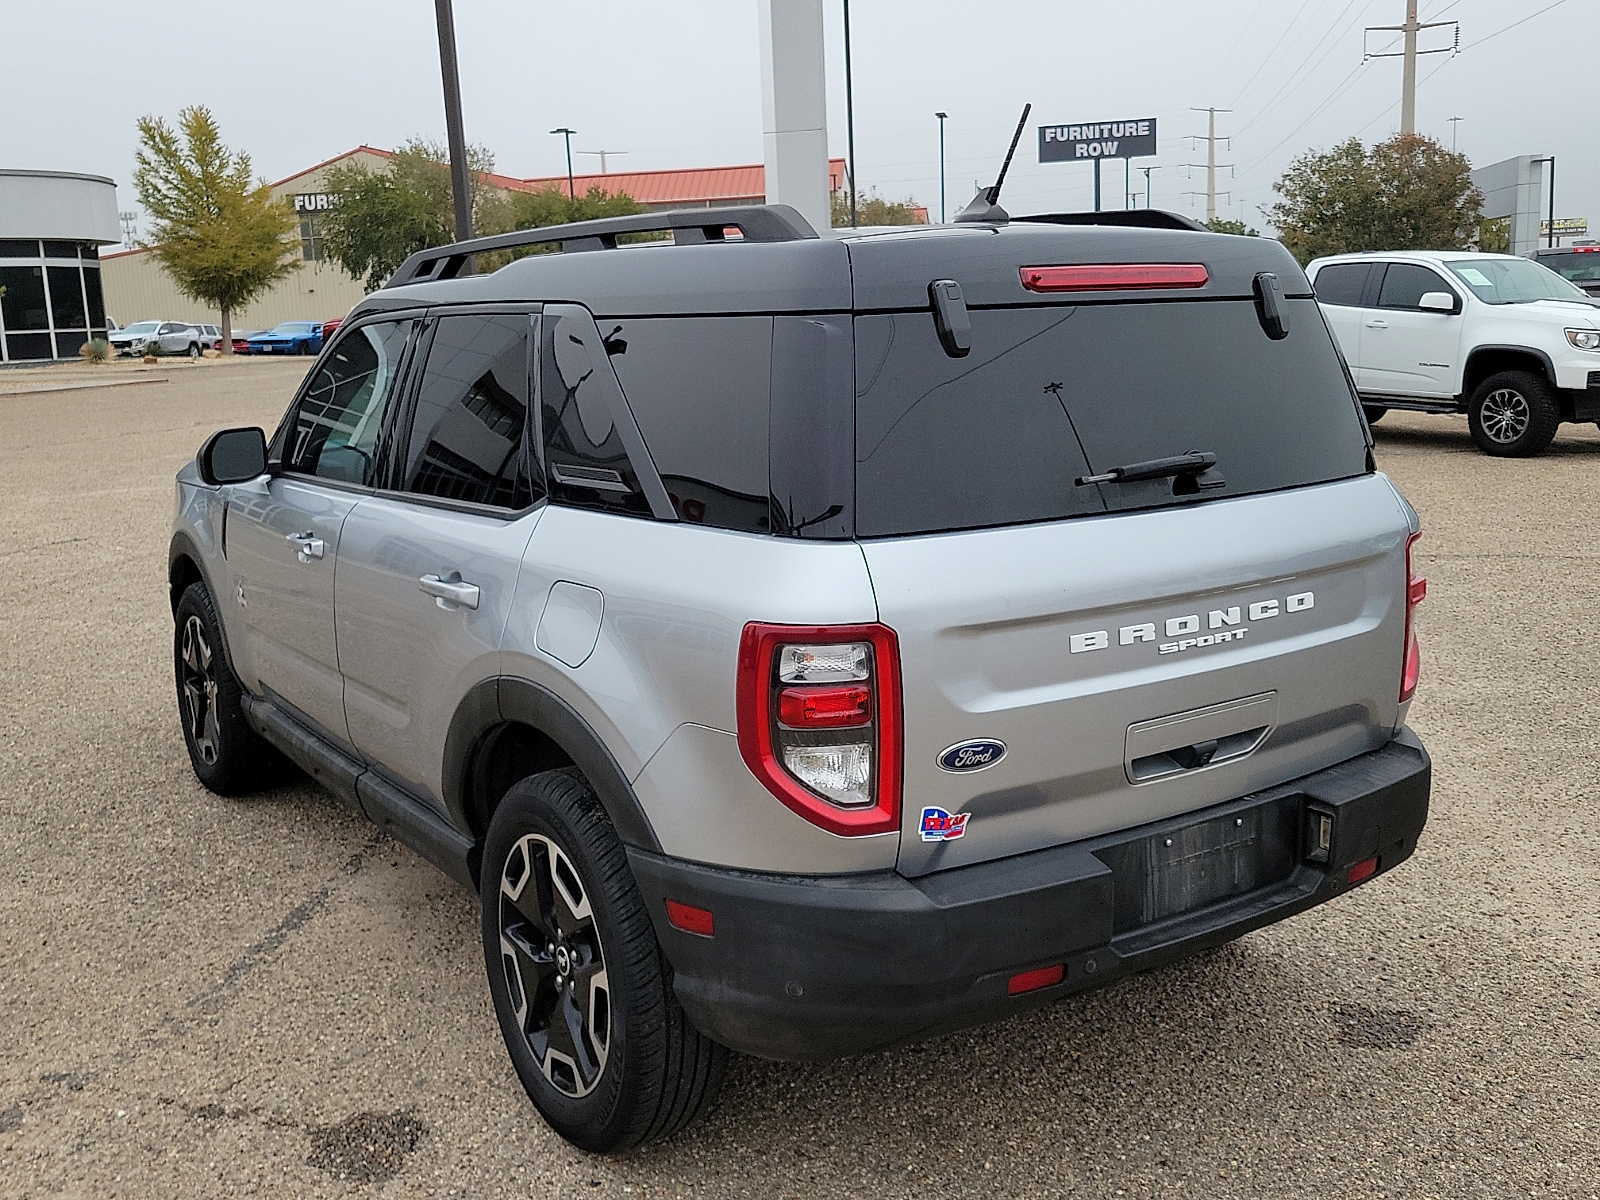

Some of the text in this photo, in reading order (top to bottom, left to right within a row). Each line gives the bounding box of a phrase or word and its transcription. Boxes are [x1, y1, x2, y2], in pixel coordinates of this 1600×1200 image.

[1045, 121, 1150, 142] FURNITURE
[1075, 142, 1119, 157] ROW
[1069, 591, 1315, 654] BRONCO
[1158, 628, 1248, 654] SPORT
[954, 746, 993, 767] Ford
